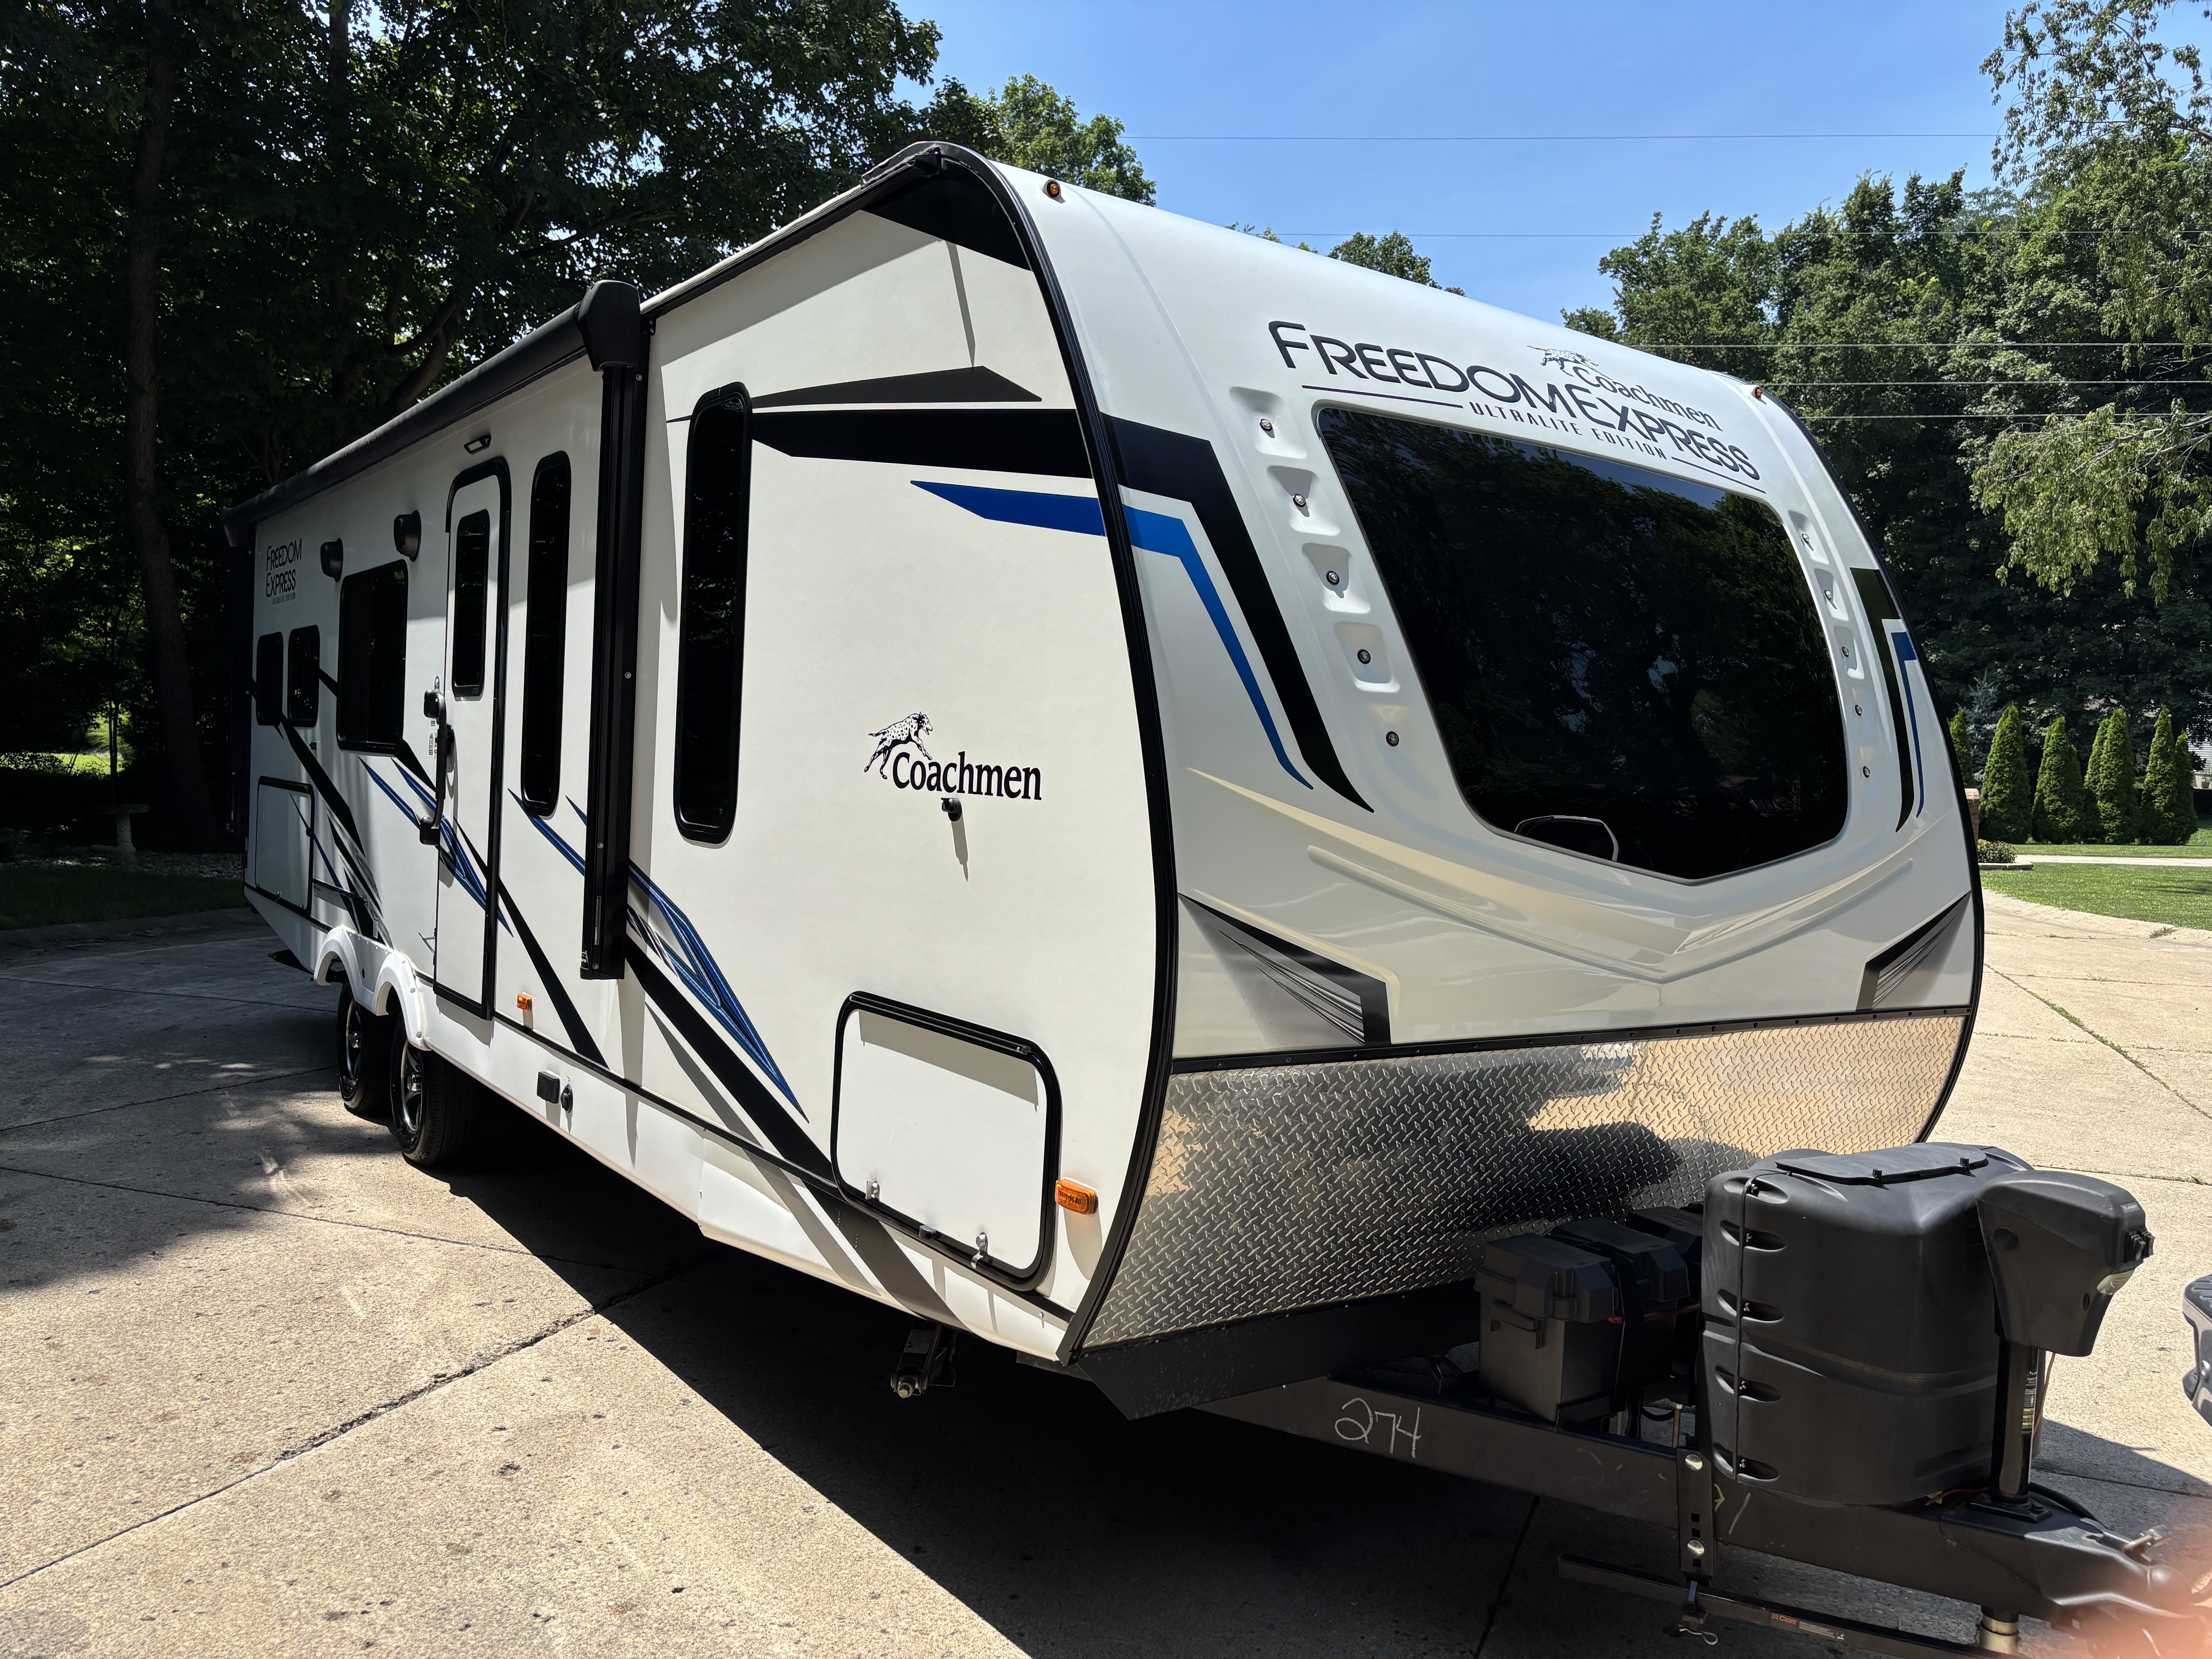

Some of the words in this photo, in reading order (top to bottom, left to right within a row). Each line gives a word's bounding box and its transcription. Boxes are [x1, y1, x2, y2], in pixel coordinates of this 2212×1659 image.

[1573, 366, 1723, 431] Coachmen
[1469, 401, 1583, 436] ULTRALITE
[1591, 428, 1667, 460] EDITION
[266, 538, 302, 571] FREEDOM
[266, 568, 296, 598] EXPRESS
[892, 751, 1042, 800] Coachmen
[1334, 1397, 1422, 1458] 274
